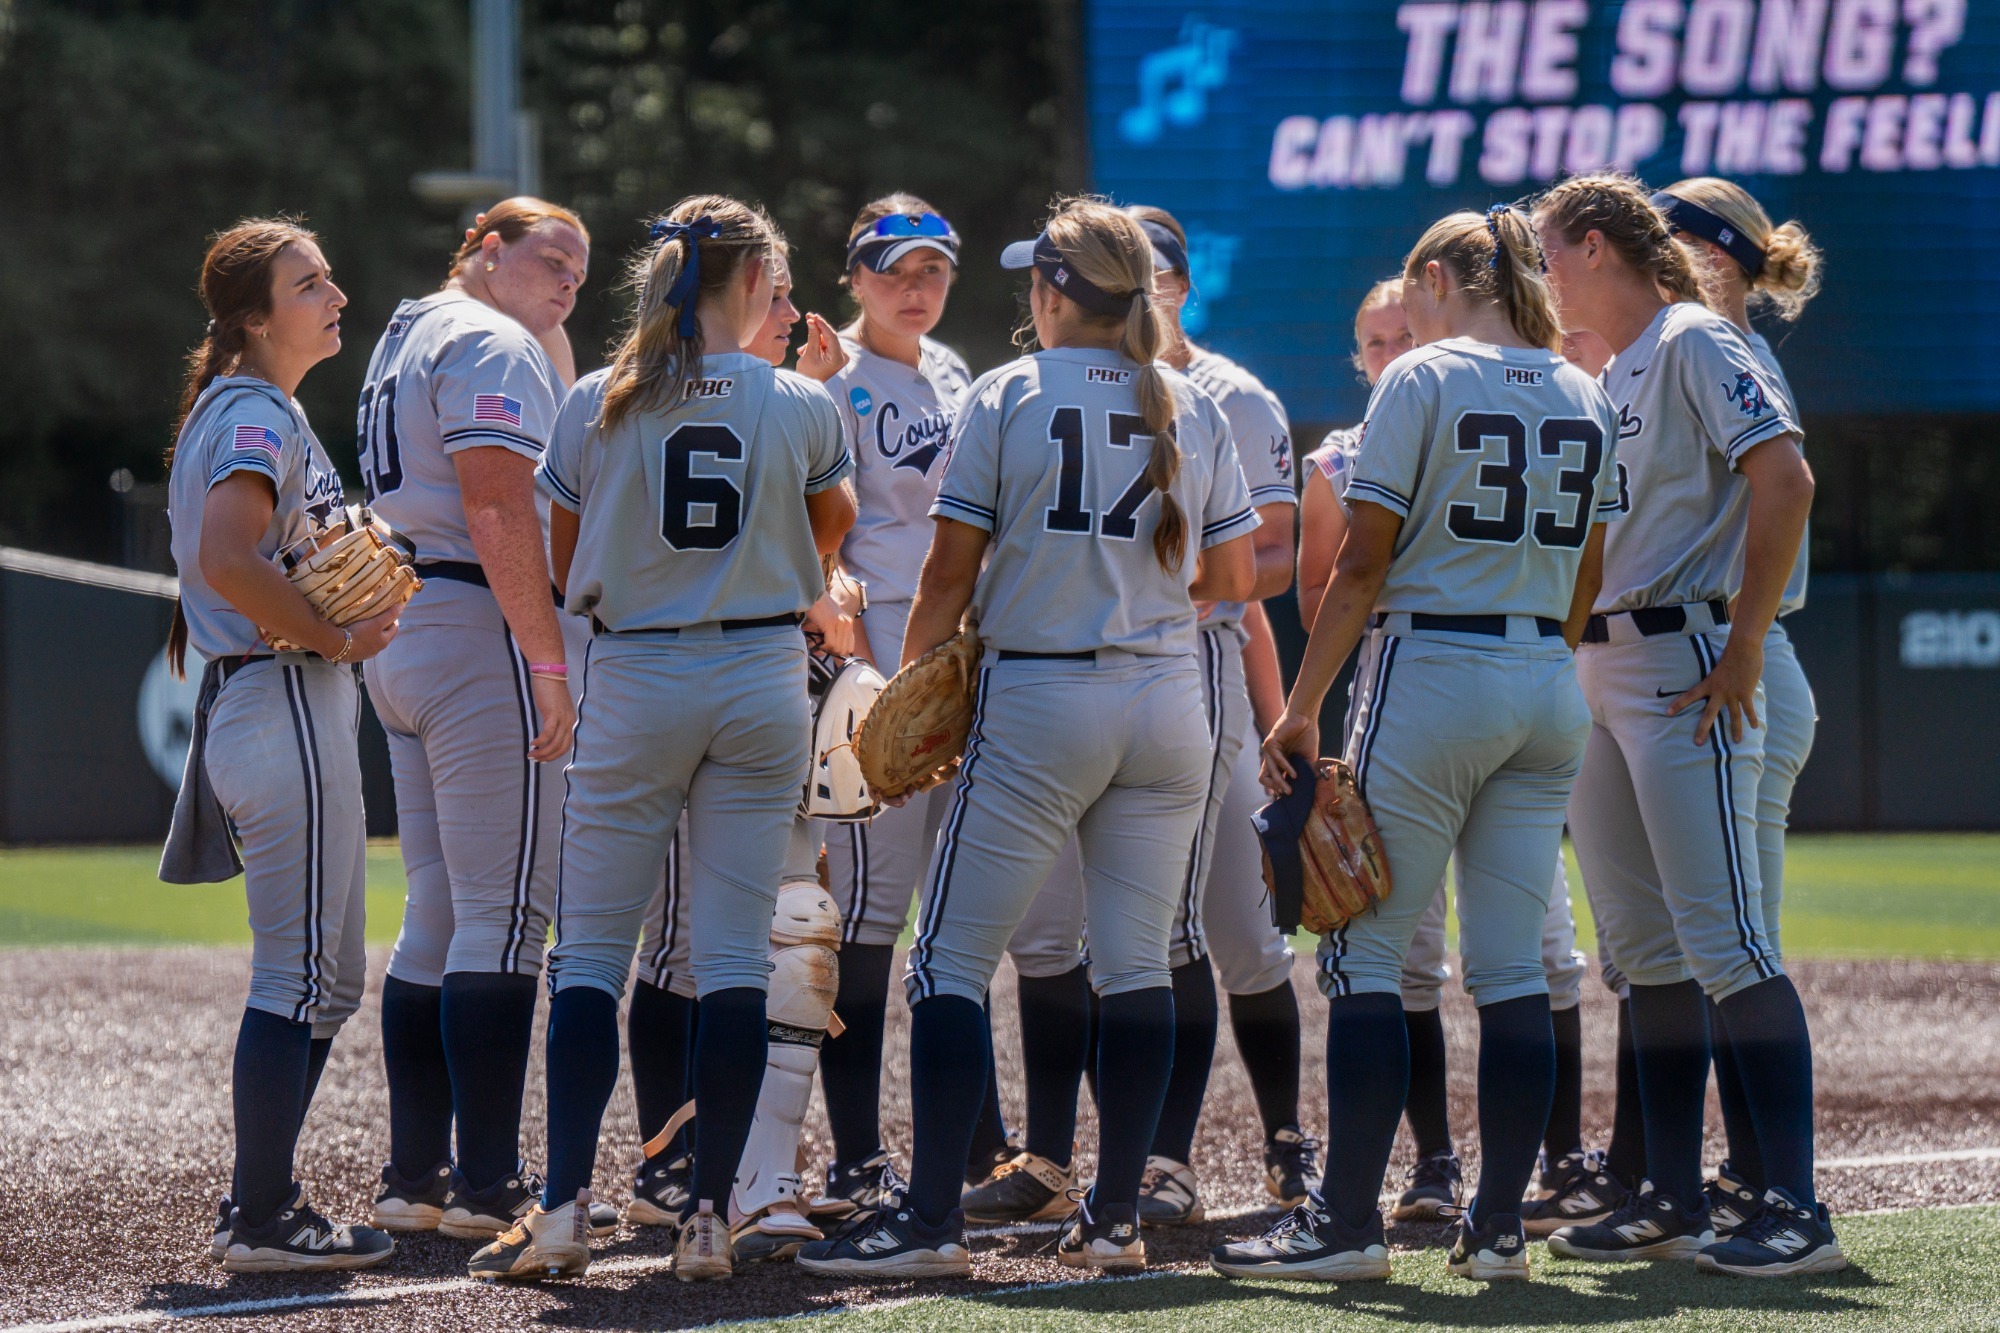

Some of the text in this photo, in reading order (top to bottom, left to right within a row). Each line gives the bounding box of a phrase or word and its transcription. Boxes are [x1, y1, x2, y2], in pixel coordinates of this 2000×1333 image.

[1397, 0, 1967, 103] THE SONG?
[1269, 110, 1475, 188] CAN'T
[1479, 104, 1665, 186] STOP
[1679, 99, 1812, 174] THE
[1086, 366, 1130, 386] PBC
[1504, 366, 1543, 387] PBC
[659, 422, 745, 551] 6
[1043, 404, 1178, 542] 17
[1444, 410, 1605, 551] 33
